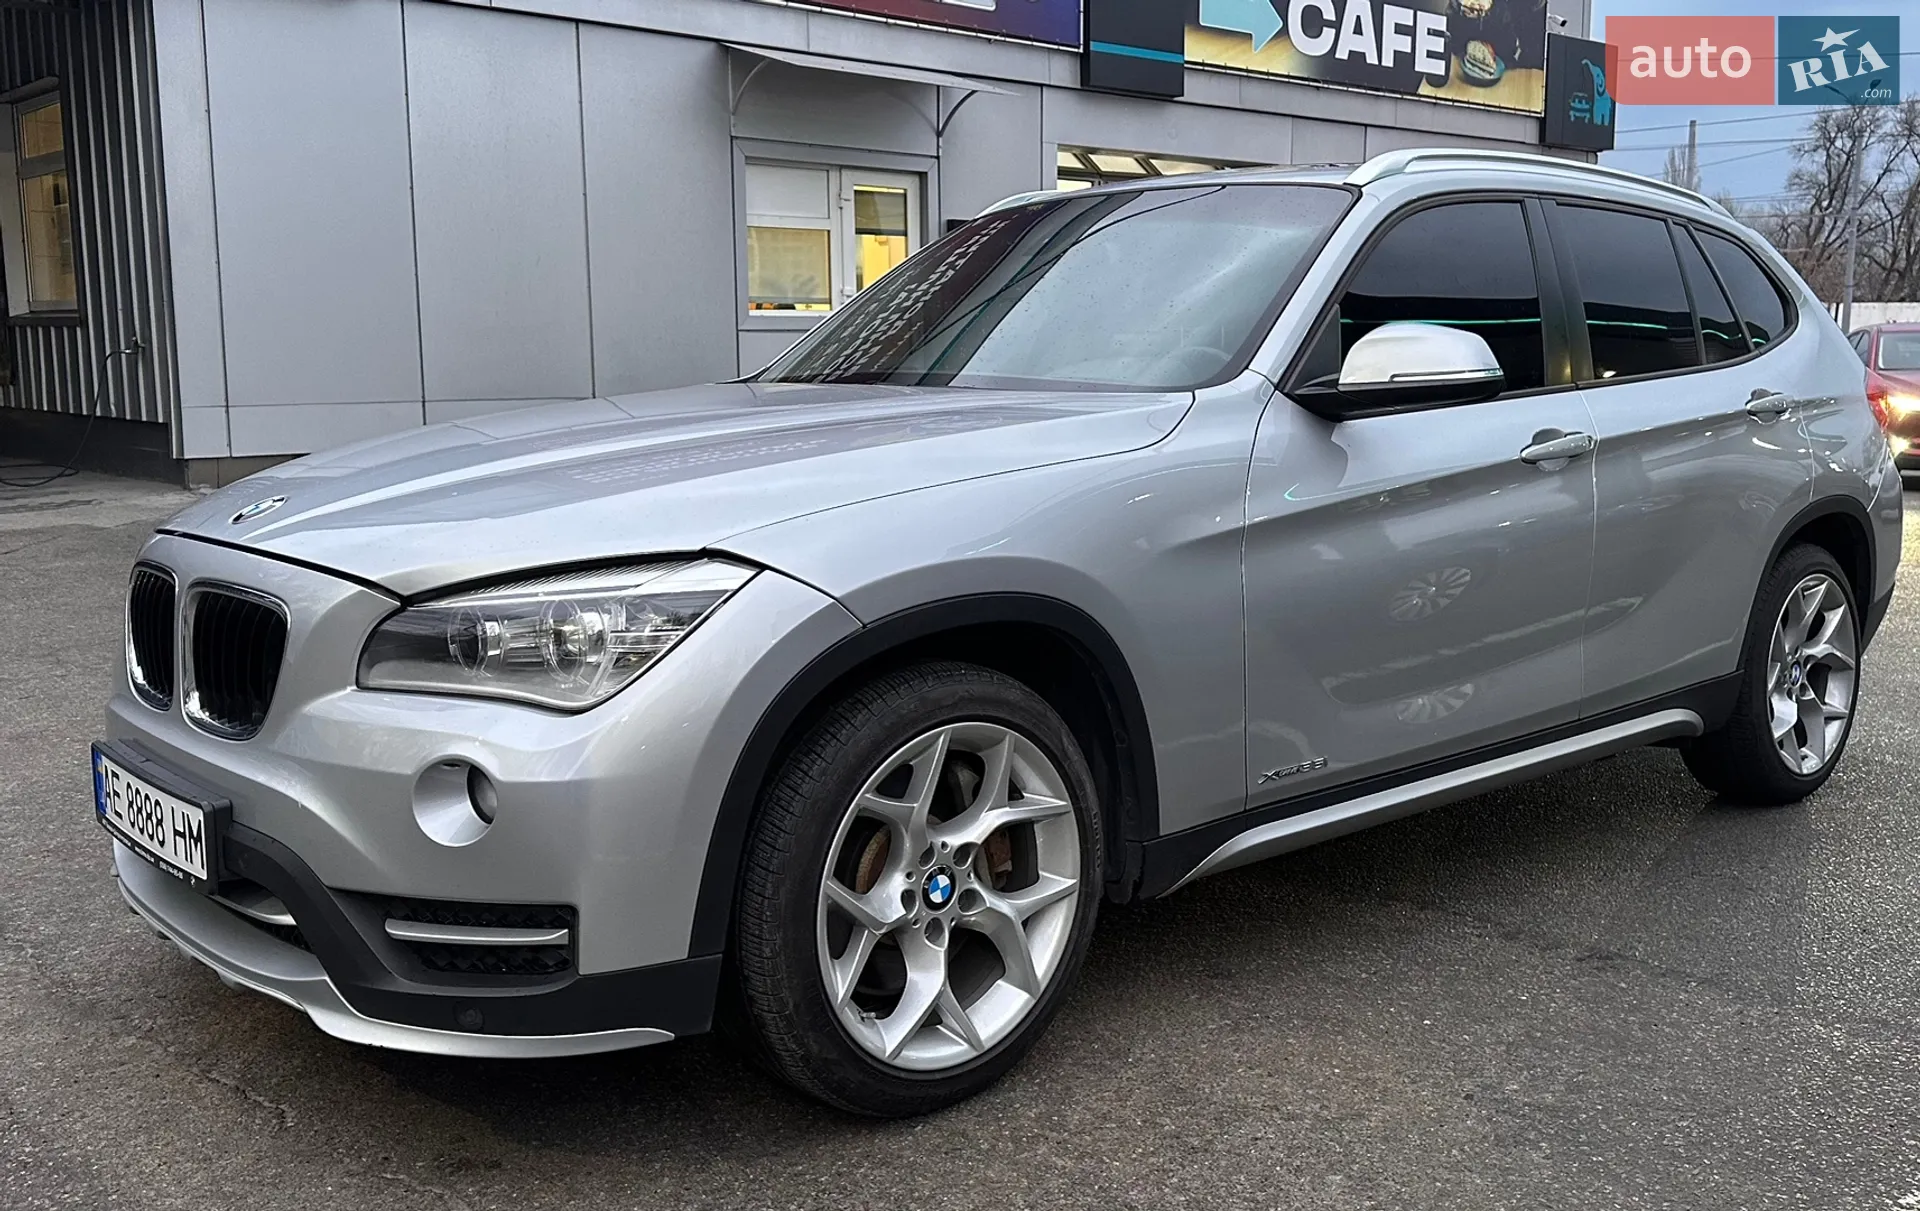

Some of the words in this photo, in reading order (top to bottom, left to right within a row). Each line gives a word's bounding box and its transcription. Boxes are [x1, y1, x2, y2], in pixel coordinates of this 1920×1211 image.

[1287, 0, 1448, 76] CAFE
[104, 765, 123, 820] AE
[126, 781, 165, 848] 8888
[171, 805, 205, 870] HM
